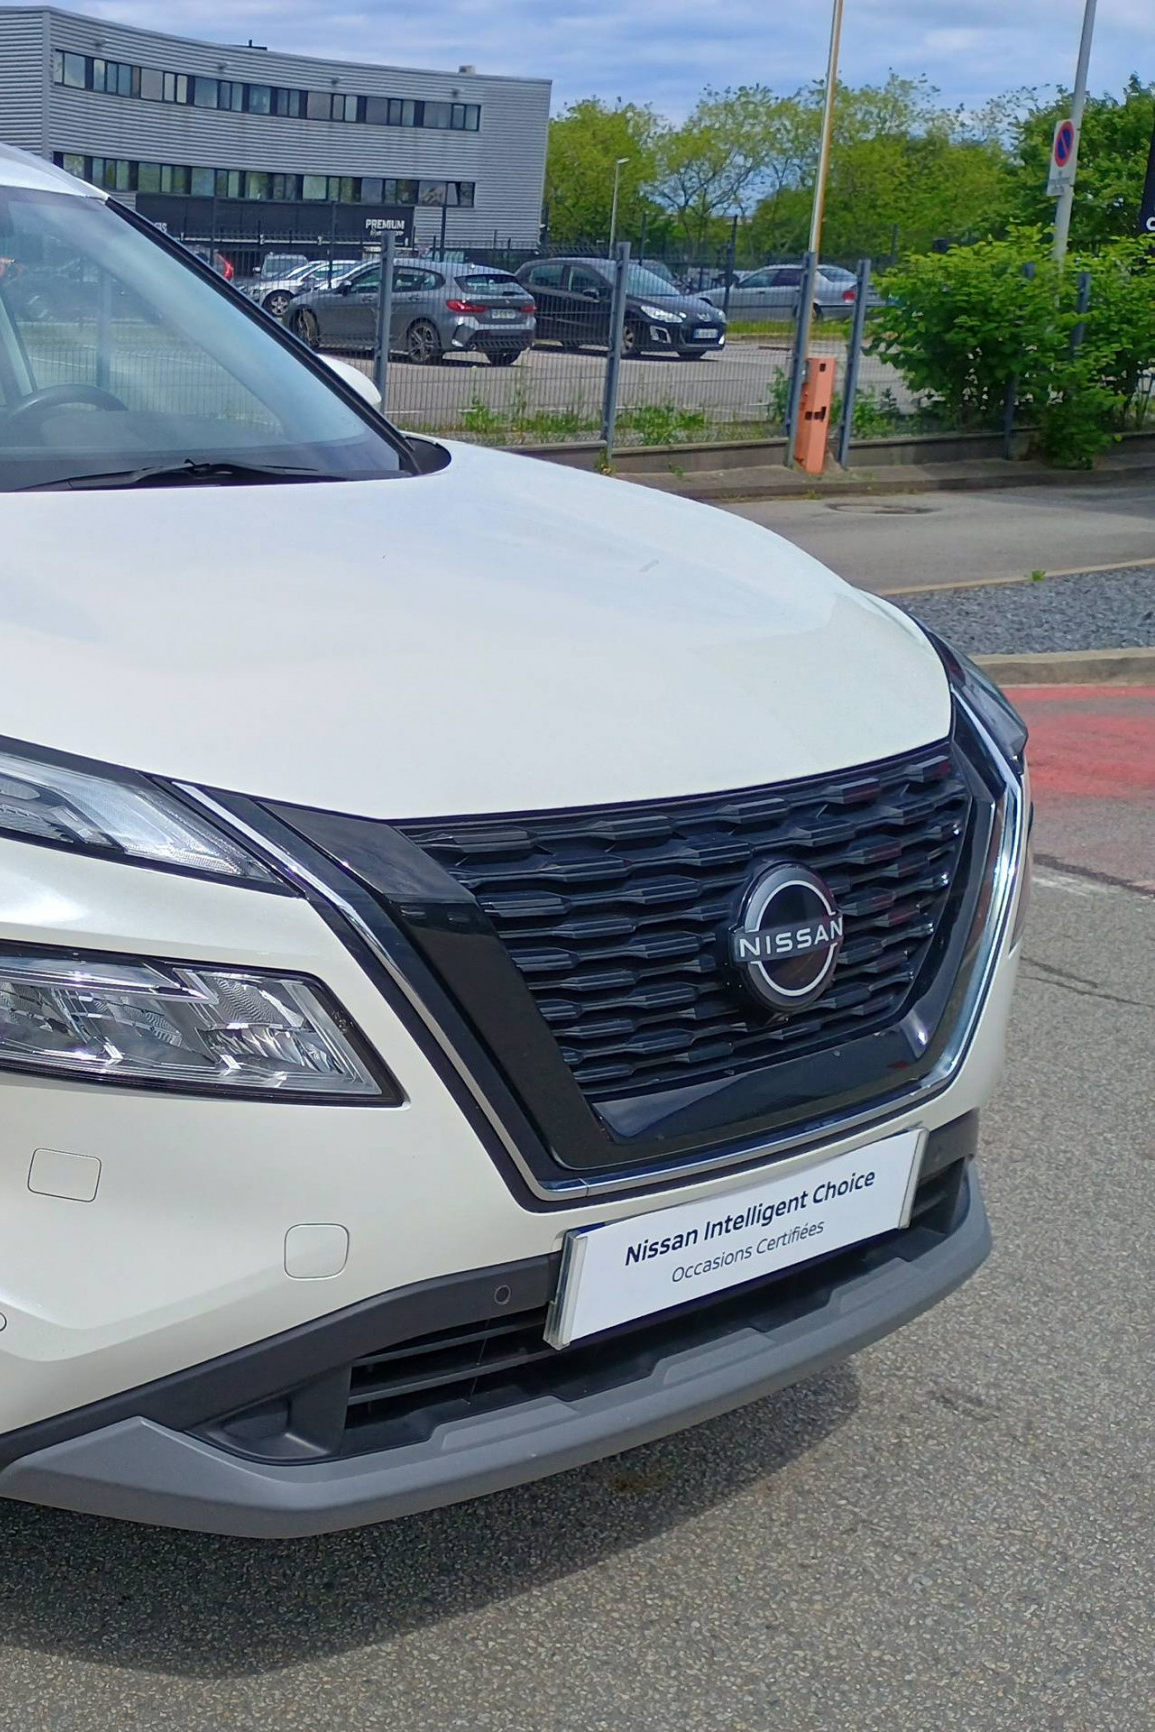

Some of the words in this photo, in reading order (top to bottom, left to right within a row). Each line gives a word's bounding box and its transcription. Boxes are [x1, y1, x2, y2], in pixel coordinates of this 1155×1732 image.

[365, 218, 405, 230] PREMIUM
[739, 916, 843, 957] NISSAN
[625, 1228, 698, 1266] Nissan
[704, 1190, 808, 1239] Intelligent
[812, 1170, 876, 1204] Choice
[671, 1245, 752, 1283] Occasions
[756, 1219, 824, 1255] Certifiées
